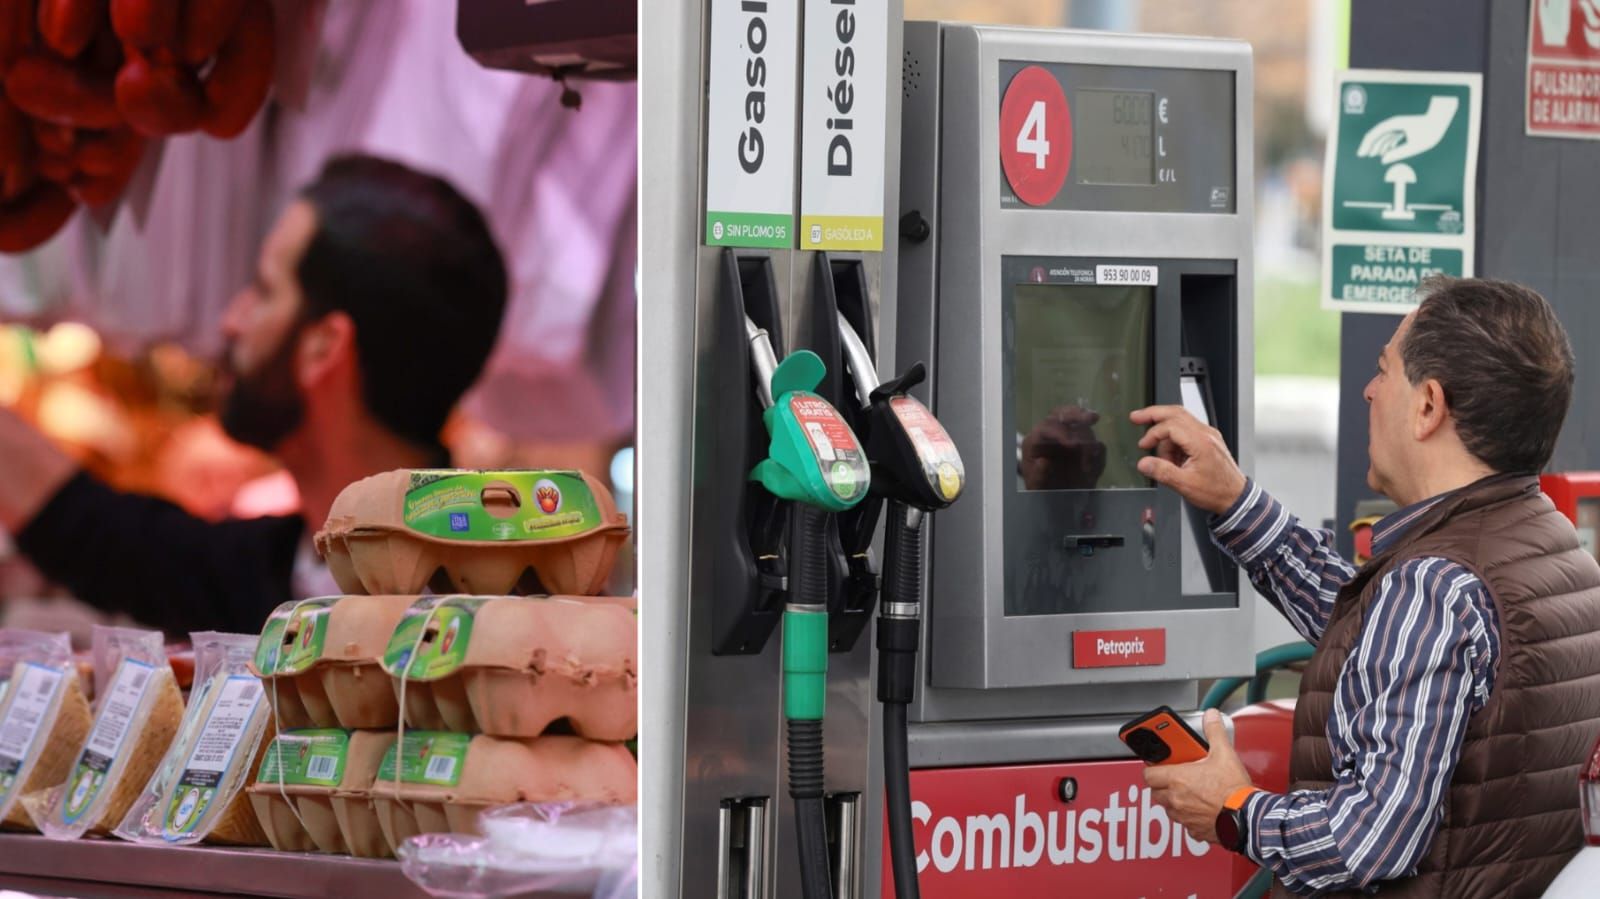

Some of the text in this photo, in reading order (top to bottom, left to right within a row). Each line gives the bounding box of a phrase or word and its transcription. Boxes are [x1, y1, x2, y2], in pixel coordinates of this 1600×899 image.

[738, 0, 768, 174] Gasol
[1158, 98, 1168, 123] €
[1016, 100, 1050, 170] 4
[727, 224, 786, 239] SIN PLOMO 95
[1364, 246, 1432, 264] SETA DE
[1103, 269, 1151, 282] 953 90 00 09
[1351, 264, 1418, 283] PARADA
[1097, 636, 1144, 659] Petroprix
